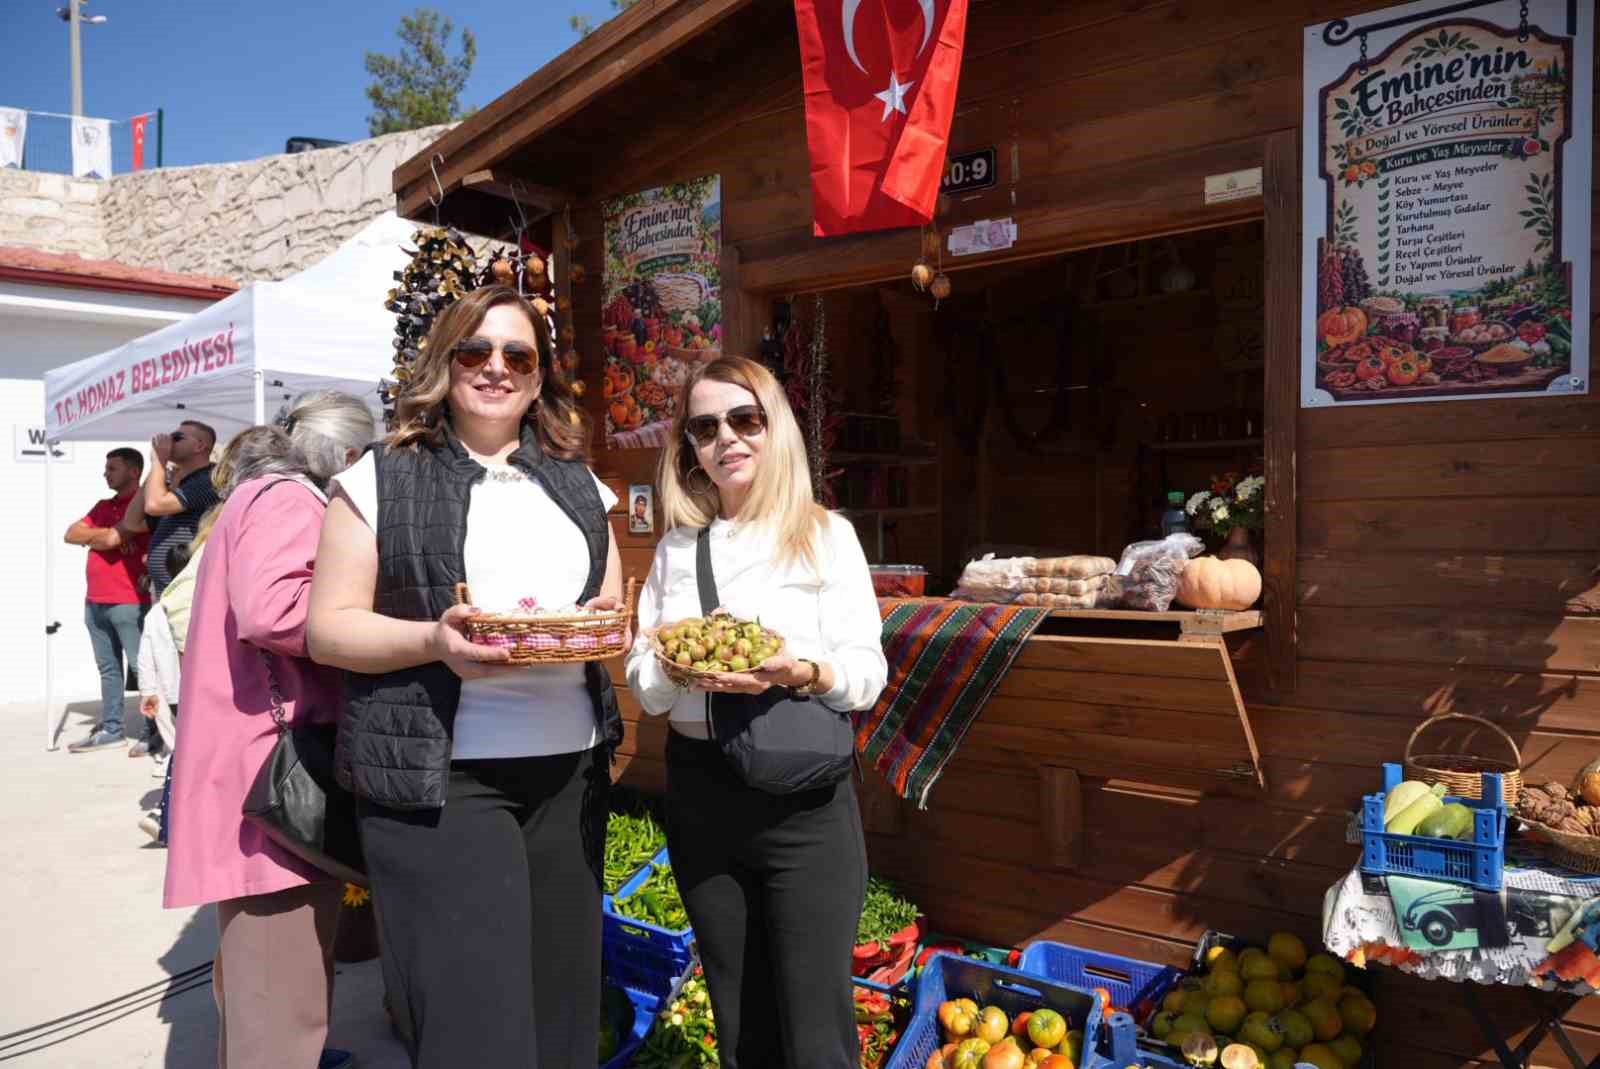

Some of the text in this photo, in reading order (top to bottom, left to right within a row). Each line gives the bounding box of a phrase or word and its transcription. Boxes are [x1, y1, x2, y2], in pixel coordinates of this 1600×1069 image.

[1351, 47, 1534, 117] Emine'nin
[1386, 79, 1507, 126] Bahçesinden
[1366, 113, 1522, 151] Doğal ve Yöresel Ürünler
[1386, 142, 1503, 169] Kuru ve Yaş Meyveler
[943, 158, 988, 187] O:9
[1395, 175, 1418, 185] Kuru
[1435, 169, 1451, 179] Yaş
[1455, 161, 1499, 177] Meyveler
[1395, 187, 1422, 198] Sebze
[1433, 181, 1464, 193] Meyve
[1395, 202, 1492, 222] Kurutulmuş Gıdalar
[1396, 194, 1468, 211] Köy Yumurtası
[624, 202, 692, 238] Emine'nin
[1397, 223, 1434, 235] Tarhana
[630, 222, 694, 252] Bahçesinden
[1397, 230, 1466, 248] Turşu Çeşitleri
[1395, 243, 1464, 260] Reçel Çeşitleri
[1395, 254, 1484, 272] Ev Yapımı Ürünler
[1395, 263, 1517, 286] Doğal ve Yöresel Ürünler
[131, 321, 235, 394] BELEDİYESİ
[28, 429, 60, 446] W
